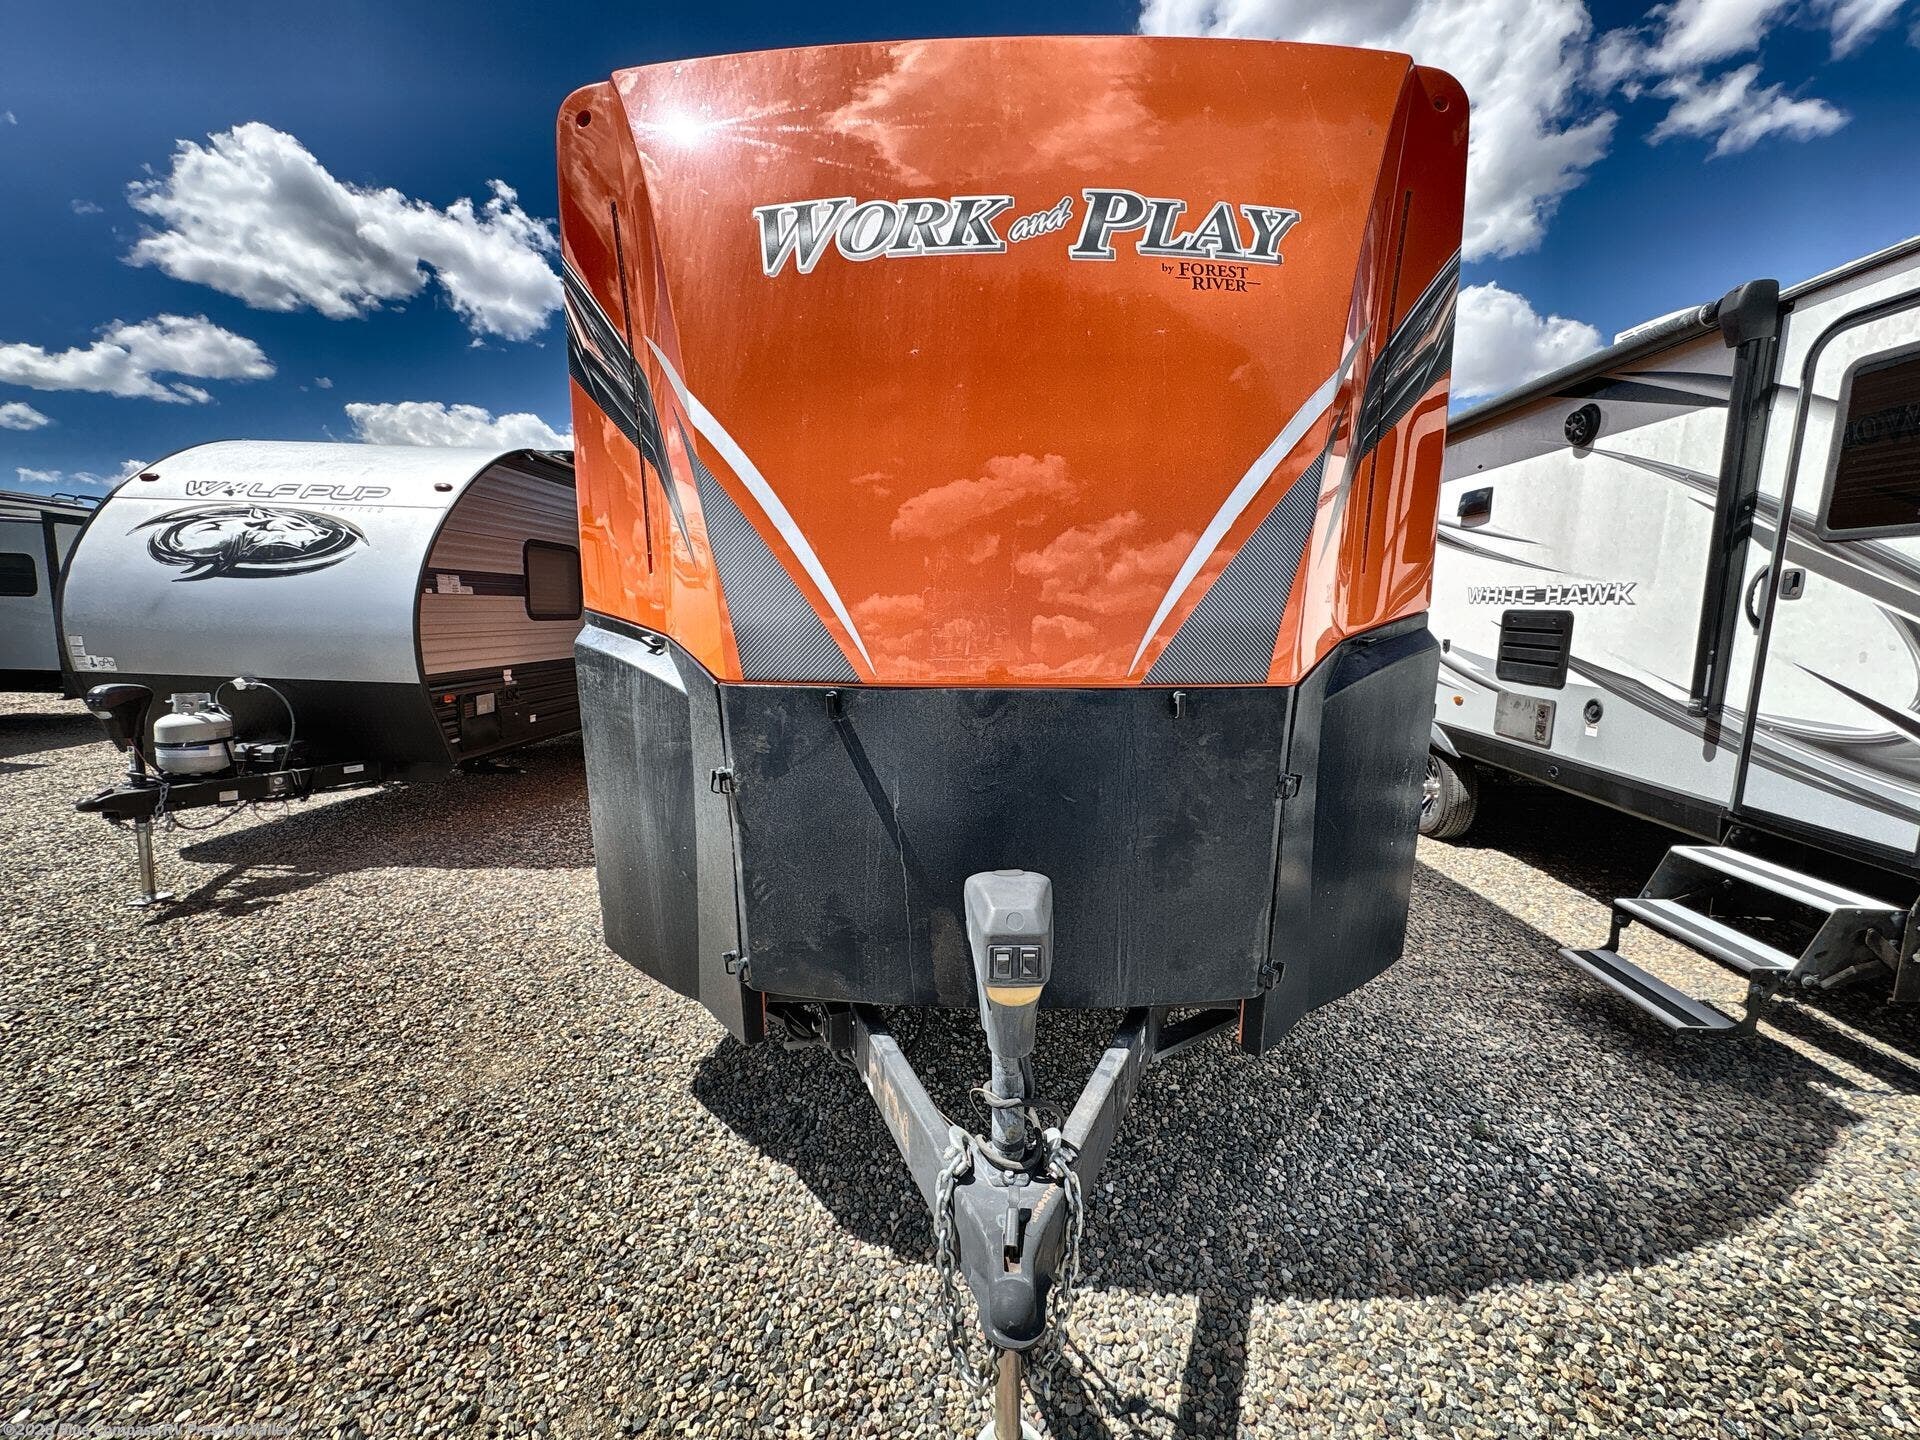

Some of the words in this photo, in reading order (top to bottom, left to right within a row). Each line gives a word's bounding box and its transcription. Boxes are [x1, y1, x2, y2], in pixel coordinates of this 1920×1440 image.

[752, 196, 1014, 277] WORK
[1008, 196, 1073, 244] and
[1068, 188, 1301, 265] PLAY
[1161, 263, 1174, 274] by
[1179, 262, 1249, 278] FOREST
[1192, 276, 1248, 292] RIVER
[299, 484, 391, 501] PUP
[321, 505, 385, 514] LIMITED
[1467, 586, 1537, 605] WHITE
[1545, 582, 1637, 606] HAWK
